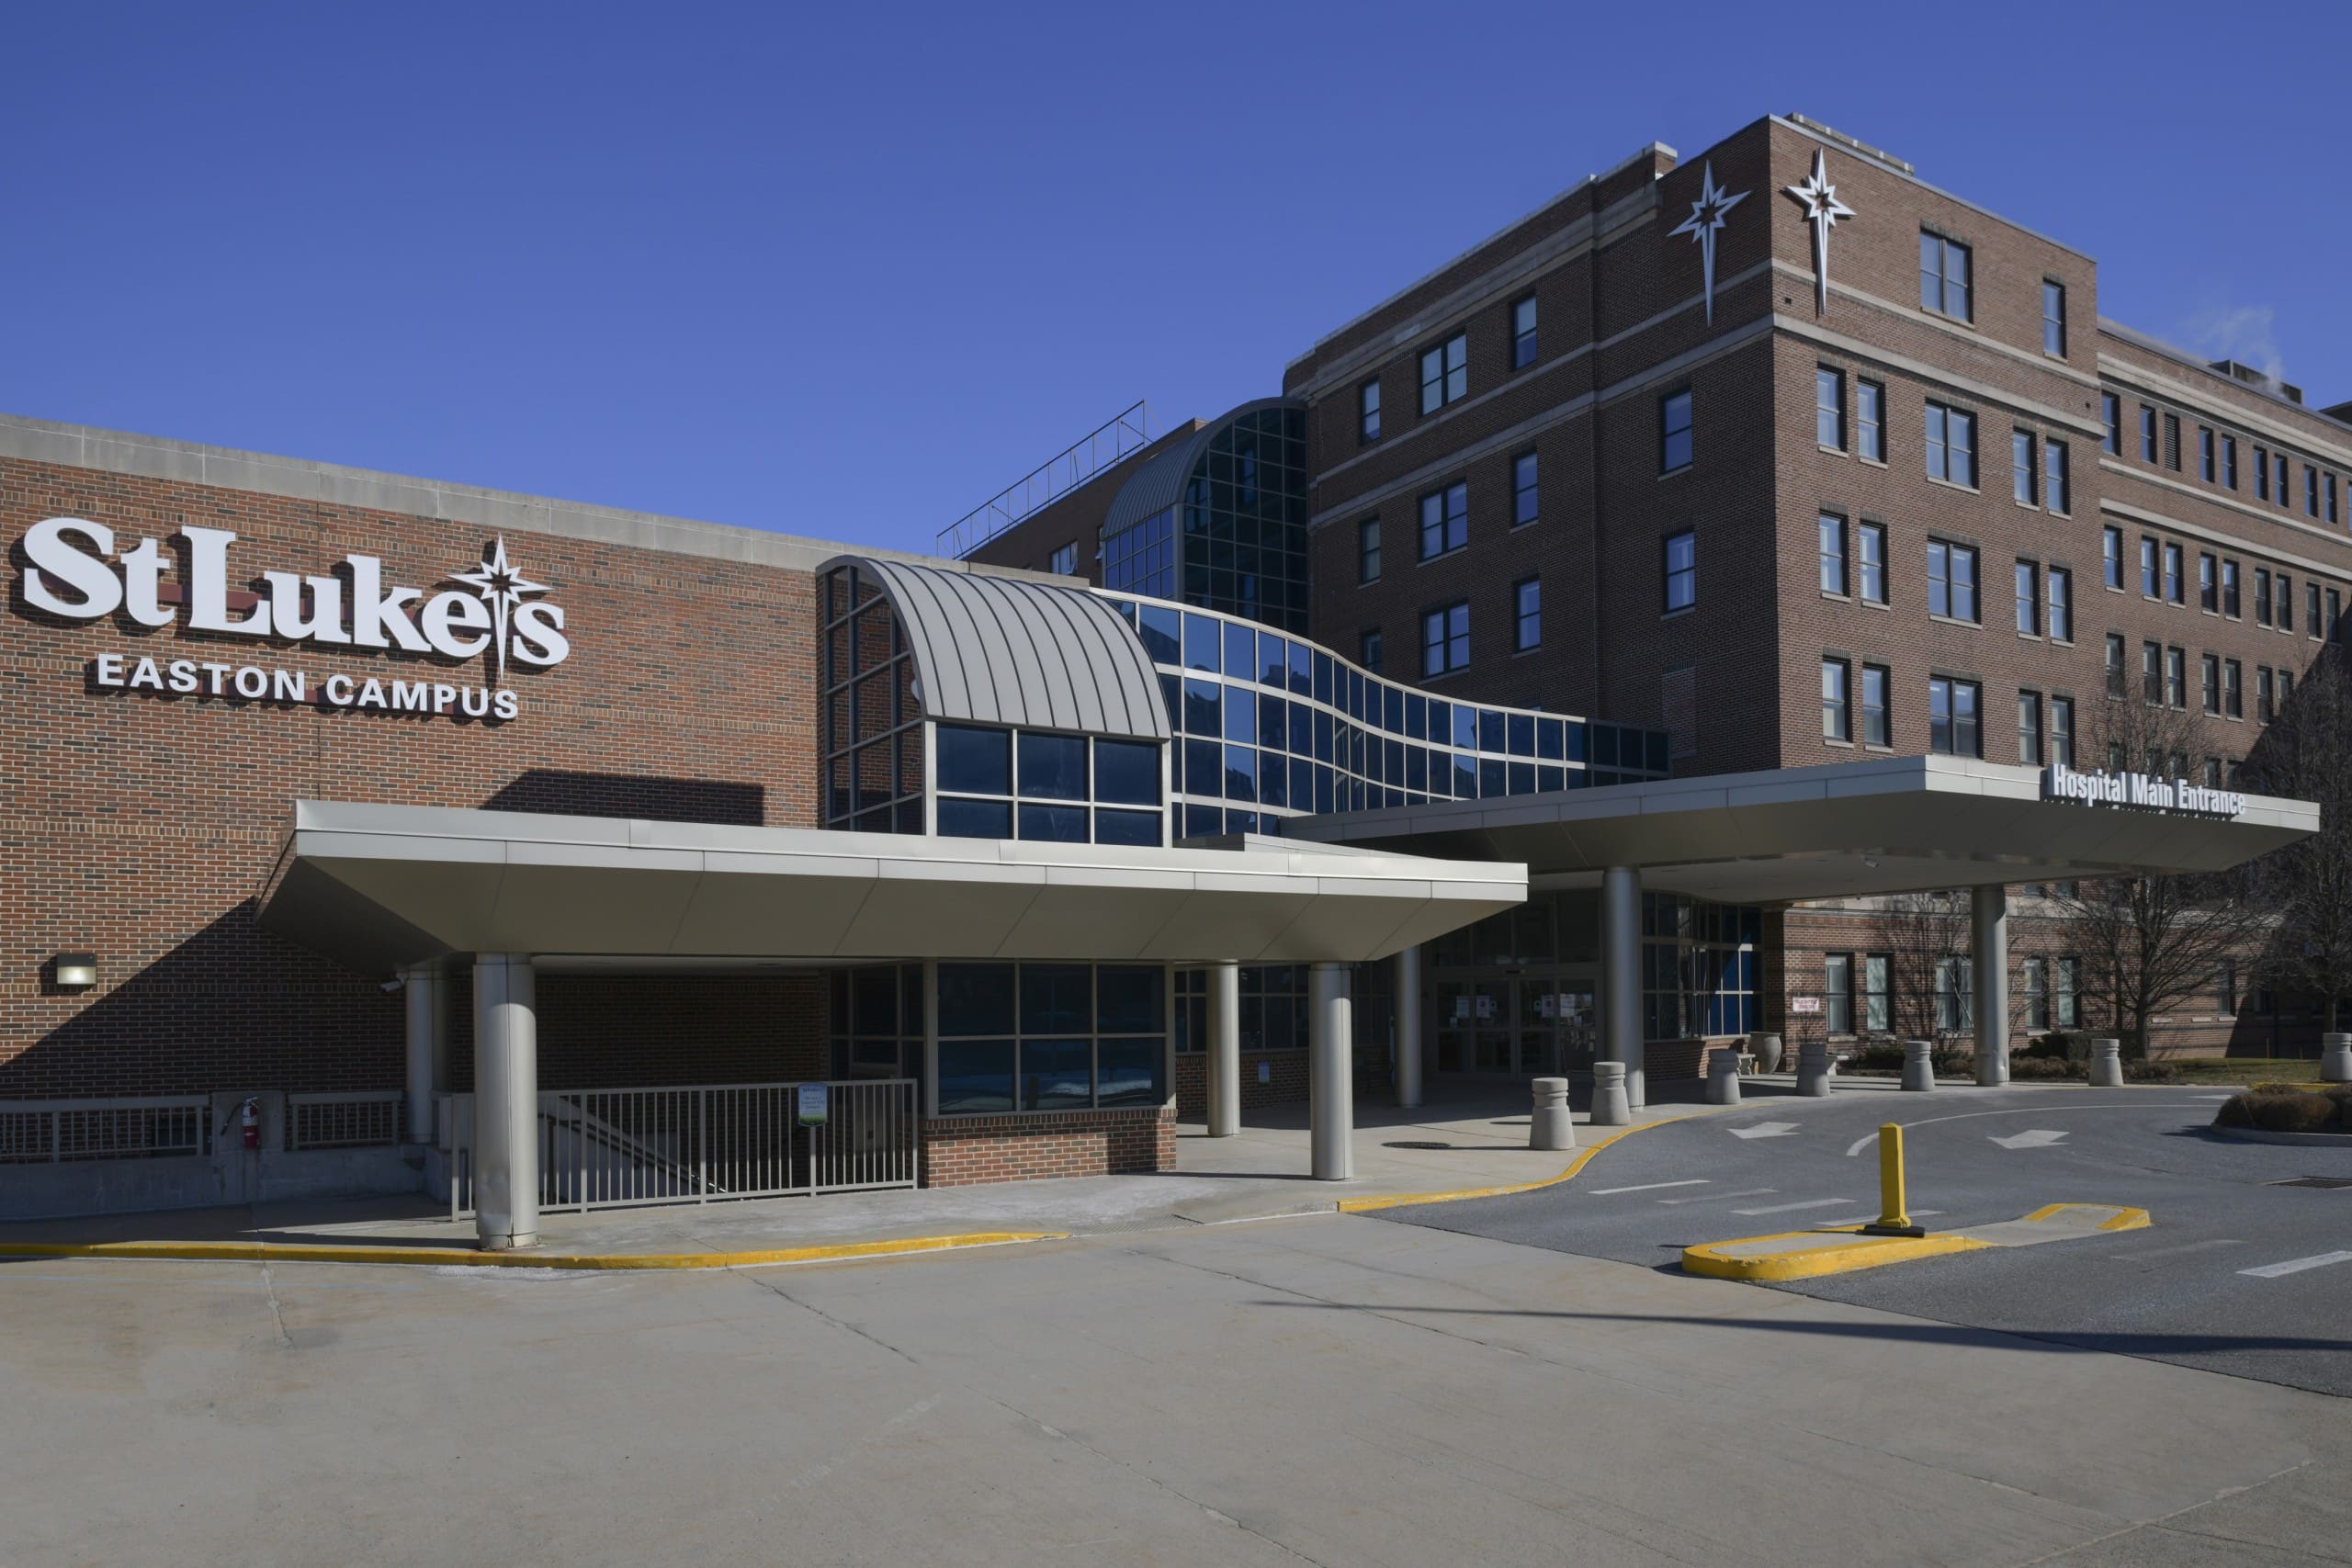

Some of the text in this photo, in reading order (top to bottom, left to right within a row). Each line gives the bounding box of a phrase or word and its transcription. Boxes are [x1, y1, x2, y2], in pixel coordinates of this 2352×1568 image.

[97, 652, 519, 719] EASTON CAMPUS
[2052, 763, 2246, 815] Hospital Main Entrance
